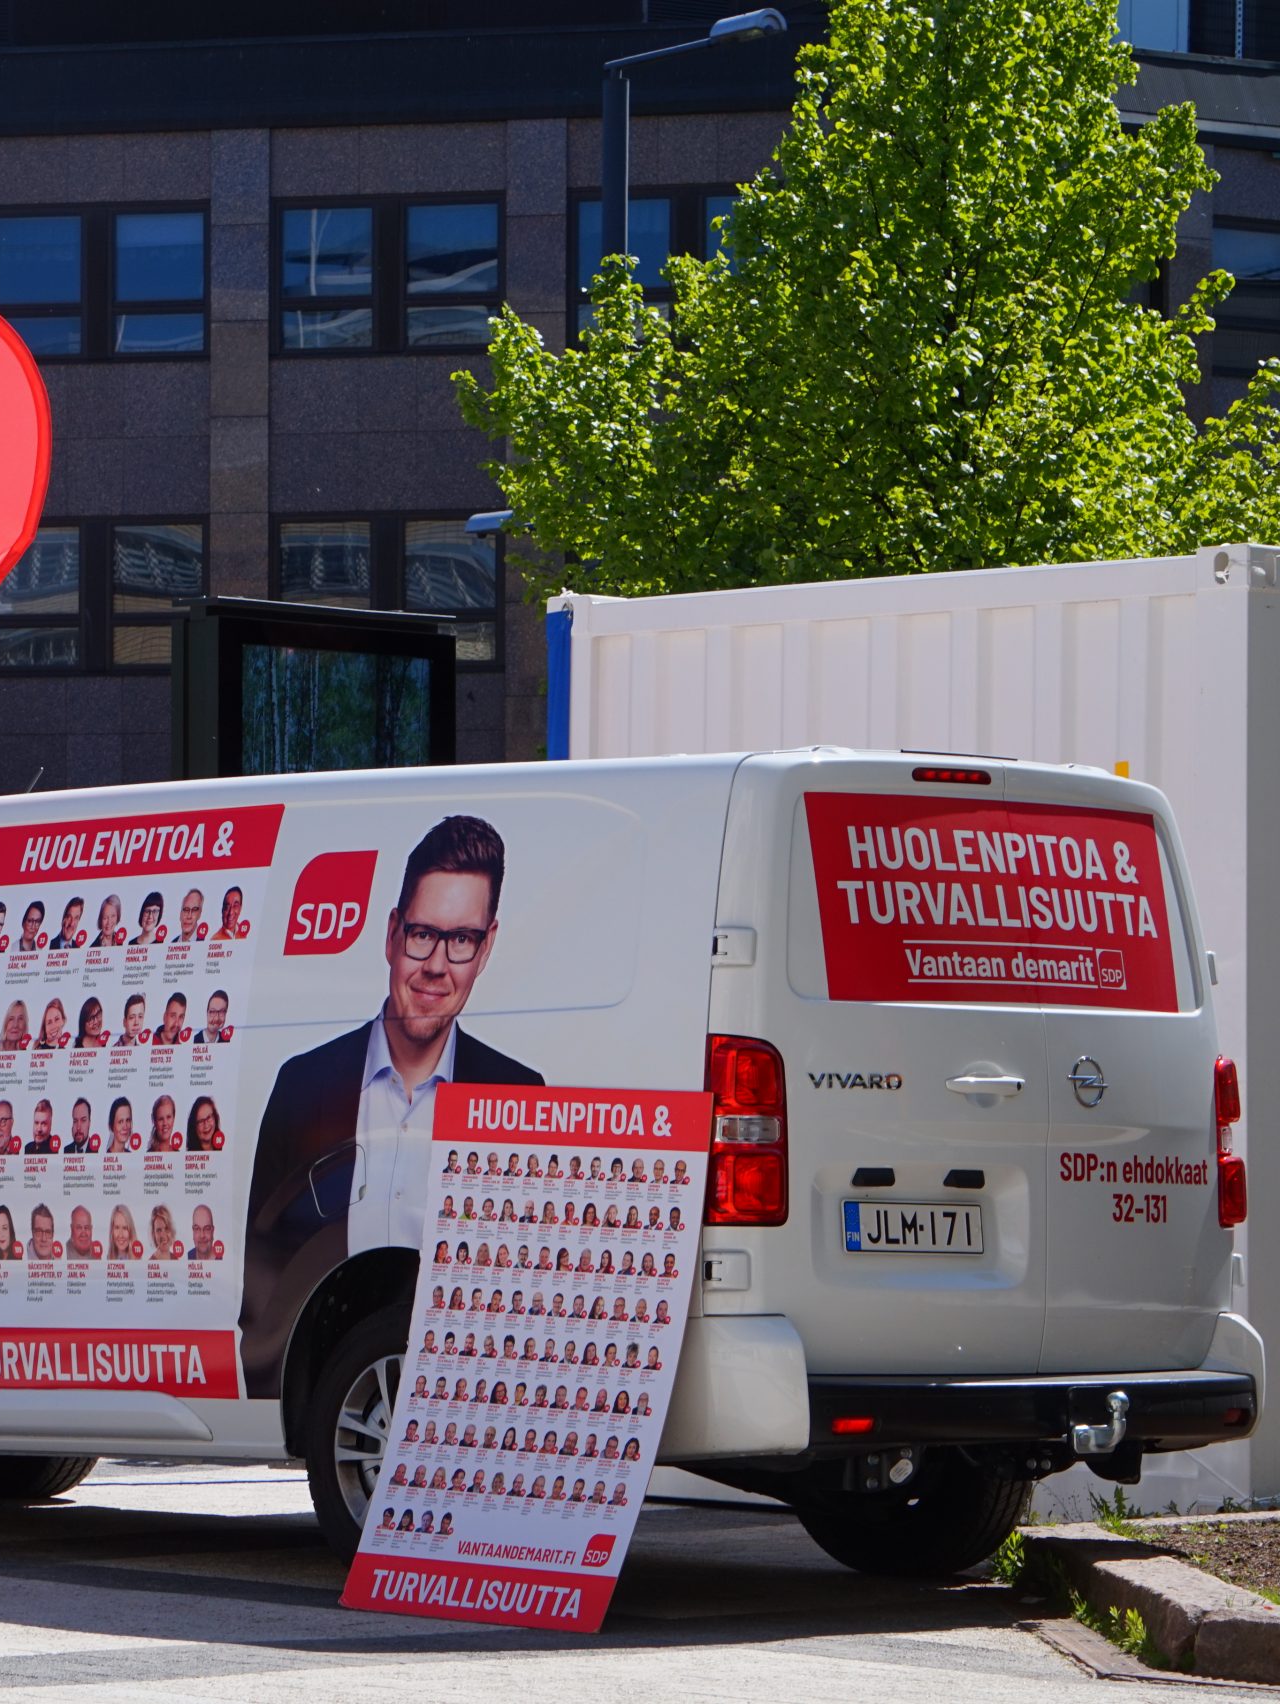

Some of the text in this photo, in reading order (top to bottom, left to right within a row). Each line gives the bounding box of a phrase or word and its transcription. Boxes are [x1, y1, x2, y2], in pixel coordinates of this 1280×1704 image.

[20, 821, 234, 873] HUOLENPITOA &
[847, 825, 1140, 885] HUOLENPITOA &
[292, 902, 361, 941] SDP
[837, 880, 1159, 939] TURVALLISUUTTA
[905, 948, 1096, 983] Vantaan demarit
[1101, 967, 1123, 984] SDP
[807, 1072, 903, 1091] VIVARO
[467, 1098, 672, 1137] HUOLENPITOA &
[1060, 1152, 1208, 1186] SDP:n ehdokkaat
[1112, 1193, 1168, 1224] 32-131
[846, 1231, 861, 1244] FIN
[457, 1541, 577, 1565] VANTAANDEMARIT.FI
[584, 1550, 609, 1565] SDP
[371, 1568, 582, 1619] TURVALLISUUTTA
